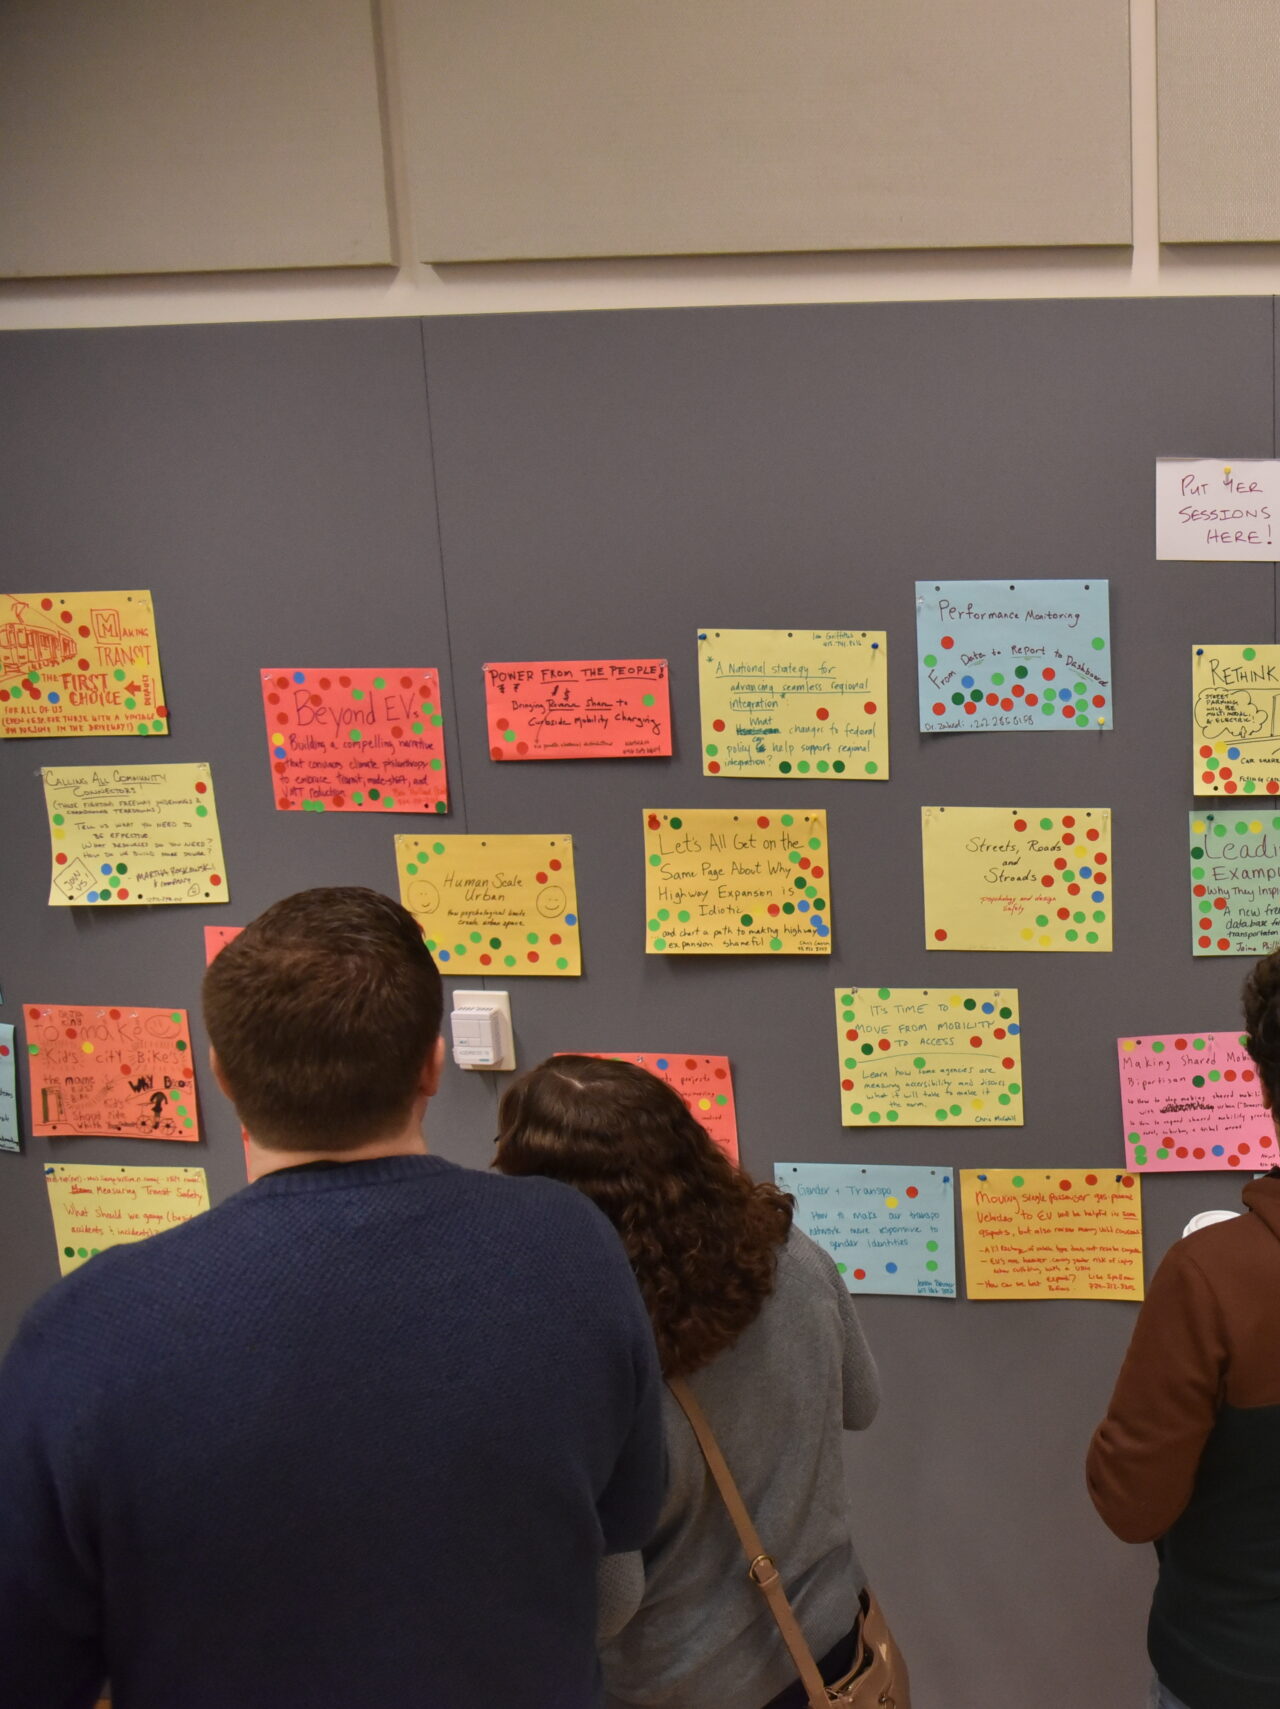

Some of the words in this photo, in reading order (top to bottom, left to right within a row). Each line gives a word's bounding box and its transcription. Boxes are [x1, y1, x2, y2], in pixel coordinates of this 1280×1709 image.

[1179, 506, 1271, 523] SESSIONS
[1207, 525, 1272, 544] HERE!
[939, 599, 1019, 622] Performance
[1025, 611, 1080, 628] Monitoring
[490, 670, 533, 686] POWER
[581, 668, 603, 677] THE
[716, 661, 723, 674] A
[729, 661, 765, 675] National
[772, 663, 808, 679] strategy
[818, 661, 836, 674] for
[928, 669, 957, 689] From
[961, 652, 985, 666] Data
[1209, 659, 1279, 685] RETHINK
[42, 674, 59, 682] THE
[62, 673, 108, 691] FIRST
[731, 682, 773, 697] advancing
[783, 682, 822, 692] seamless
[831, 678, 868, 695] regional
[69, 692, 121, 706] CHOICE
[293, 689, 376, 737] Beyond
[750, 718, 772, 726] What
[772, 742, 794, 753] help
[801, 743, 831, 754] support
[659, 834, 701, 855] Let's
[709, 833, 726, 852] All
[733, 833, 757, 850] Get
[763, 839, 776, 849] on
[780, 831, 804, 849] the
[966, 837, 1020, 854] Streets,
[1028, 840, 1062, 852] Roads
[1002, 857, 1021, 866] and
[660, 863, 697, 881] Same
[702, 862, 724, 881] Page
[731, 861, 761, 875] About
[768, 860, 791, 877] Why
[984, 867, 1037, 883] Stroads
[444, 871, 488, 888] Human
[492, 873, 522, 889] Scale
[465, 889, 505, 901] Urban
[658, 886, 708, 904] Highway
[782, 888, 794, 896] is
[1224, 907, 1231, 916] A
[1239, 907, 1260, 917] new
[894, 1004, 928, 1014] TIME
[938, 1004, 948, 1012] TO
[855, 1025, 891, 1034] MOVE
[899, 1024, 927, 1032] FROM
[937, 1020, 995, 1030] MOBILITY
[894, 1039, 908, 1047] TO
[920, 1037, 955, 1046] ACCESS
[1123, 1057, 1171, 1070] Making
[1181, 1054, 1217, 1066] Shared
